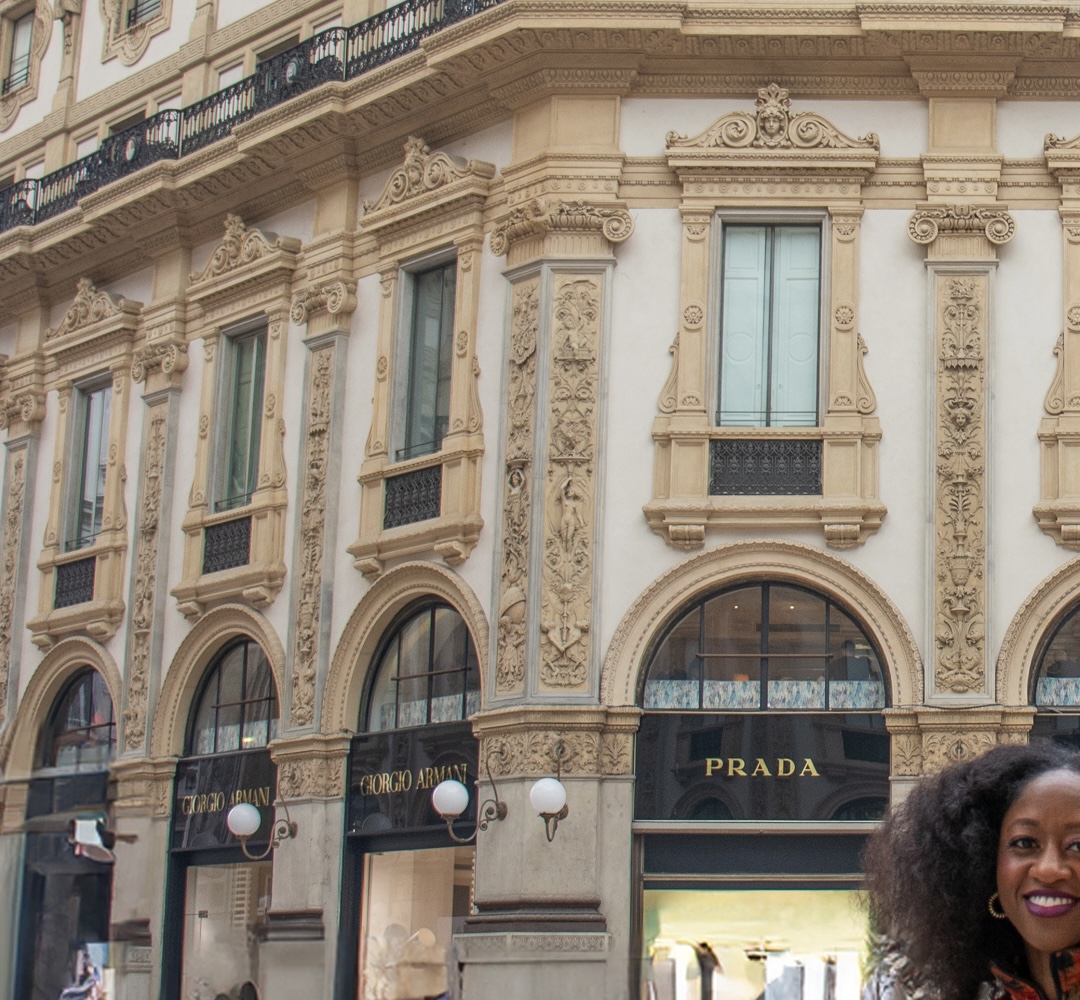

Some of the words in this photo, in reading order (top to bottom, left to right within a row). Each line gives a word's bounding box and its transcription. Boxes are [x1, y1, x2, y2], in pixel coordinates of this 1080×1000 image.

[705, 758, 820, 776] PRADA
[361, 770, 412, 796] GIORGIO
[182, 792, 225, 815] GIORGIO
